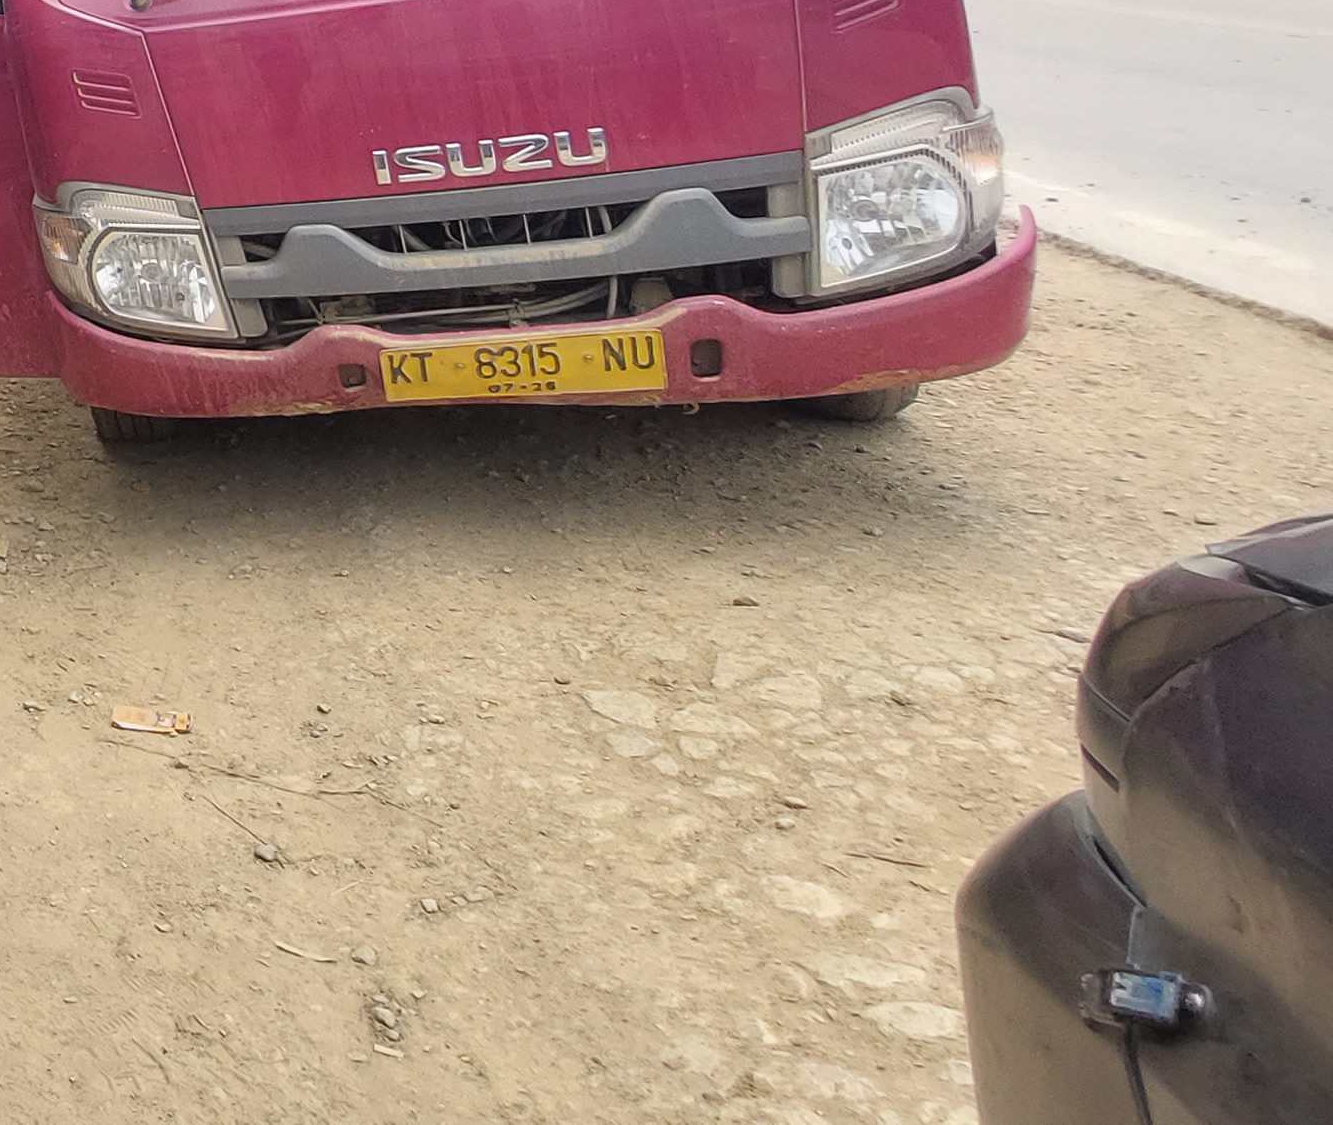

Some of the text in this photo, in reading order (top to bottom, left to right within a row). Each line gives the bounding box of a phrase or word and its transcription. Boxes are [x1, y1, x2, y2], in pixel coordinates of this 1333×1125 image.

[372, 127, 608, 185] ISUZU
[387, 335, 656, 385] KT 8315 NU
